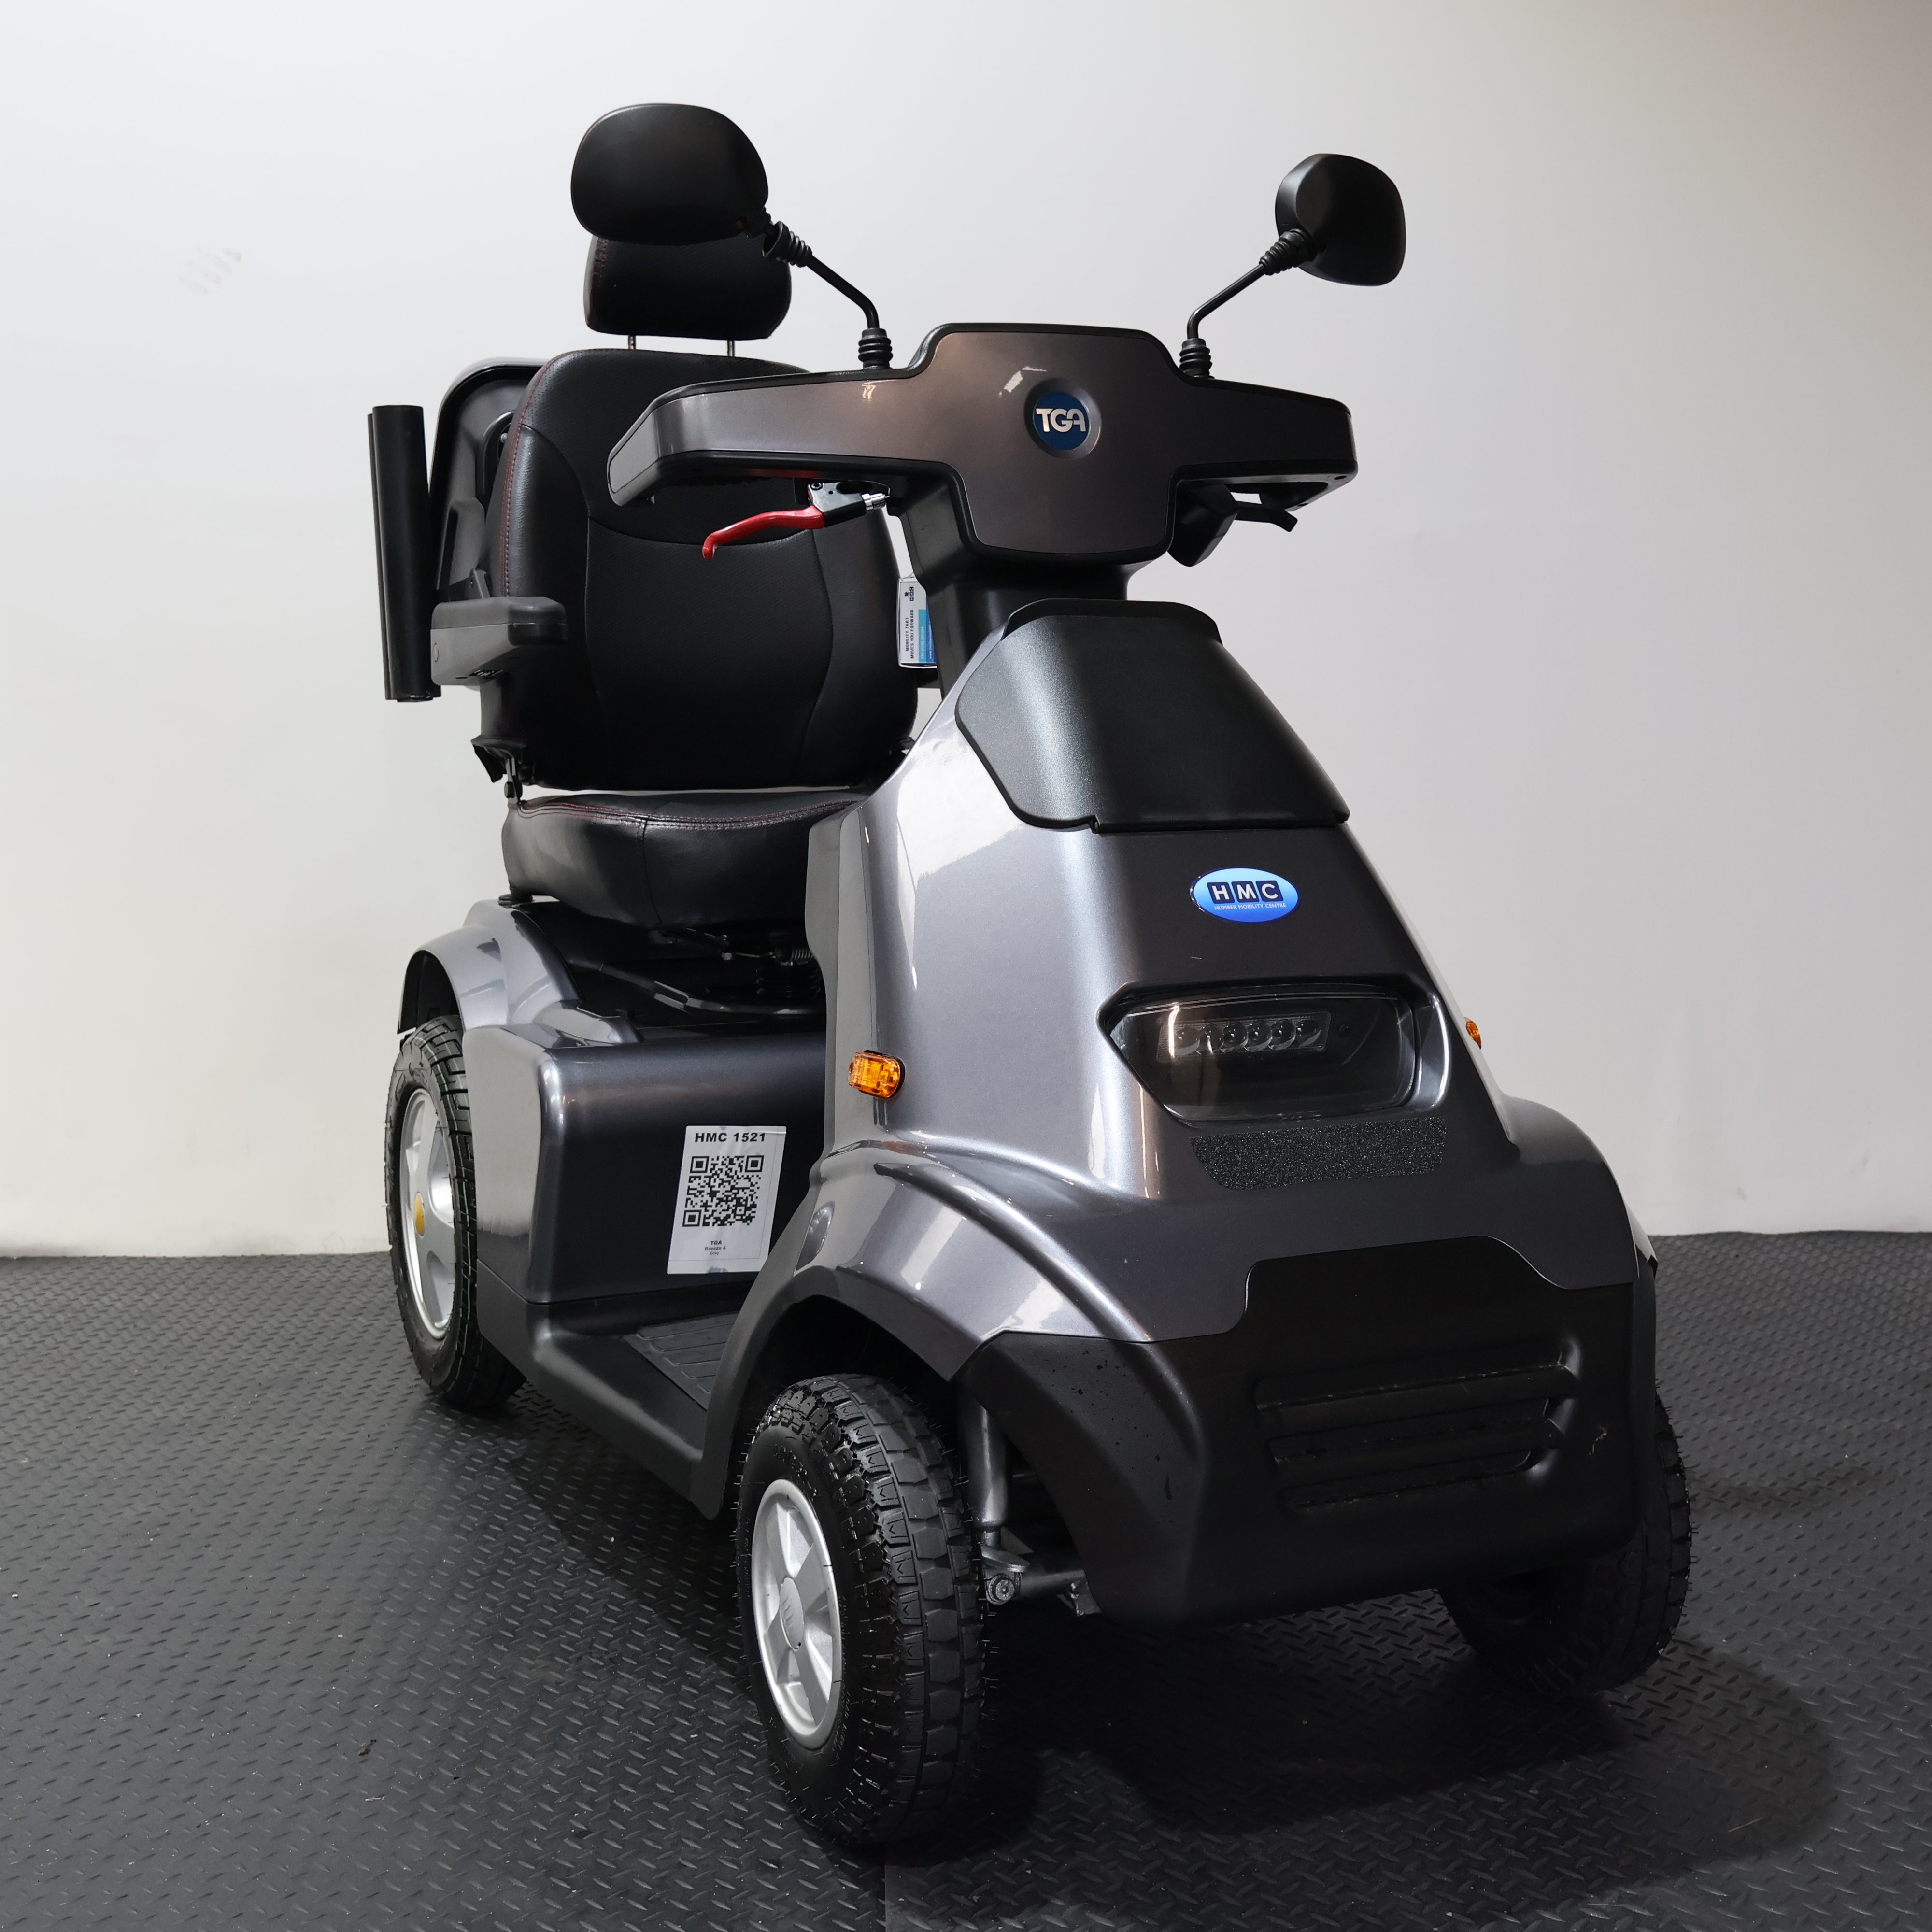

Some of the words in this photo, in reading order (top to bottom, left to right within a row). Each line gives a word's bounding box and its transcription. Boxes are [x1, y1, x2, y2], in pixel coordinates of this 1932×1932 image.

[1036, 408, 1086, 433] TGA
[1211, 883, 1279, 901] HMC
[695, 1133, 727, 1142] HMC
[733, 1132, 766, 1142] 1521
